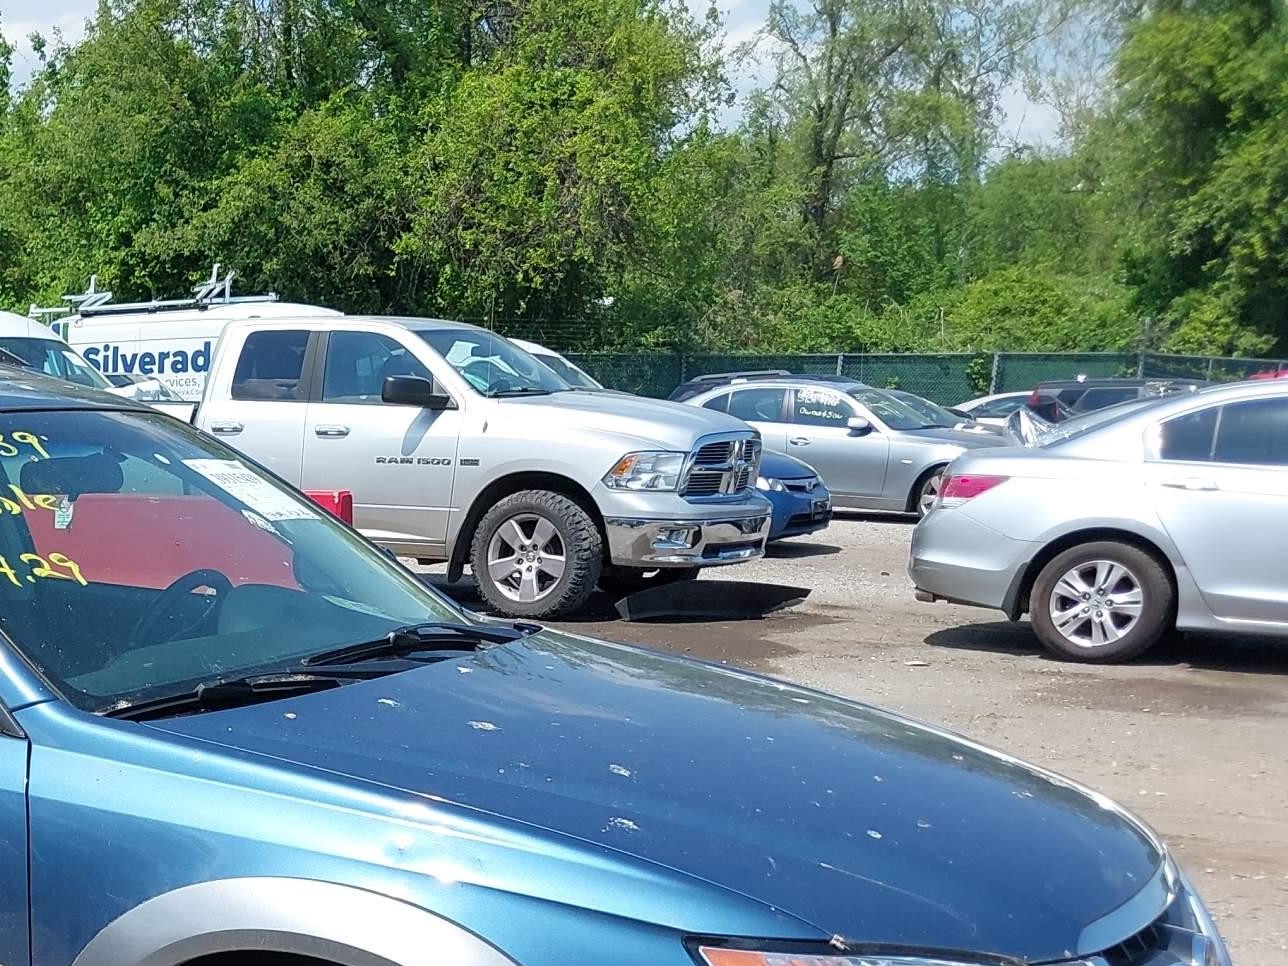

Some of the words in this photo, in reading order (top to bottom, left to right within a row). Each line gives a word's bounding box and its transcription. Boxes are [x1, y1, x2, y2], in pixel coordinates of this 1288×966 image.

[83, 341, 211, 374] Silverad
[375, 456, 414, 465] RAM
[417, 457, 452, 466] 1500
